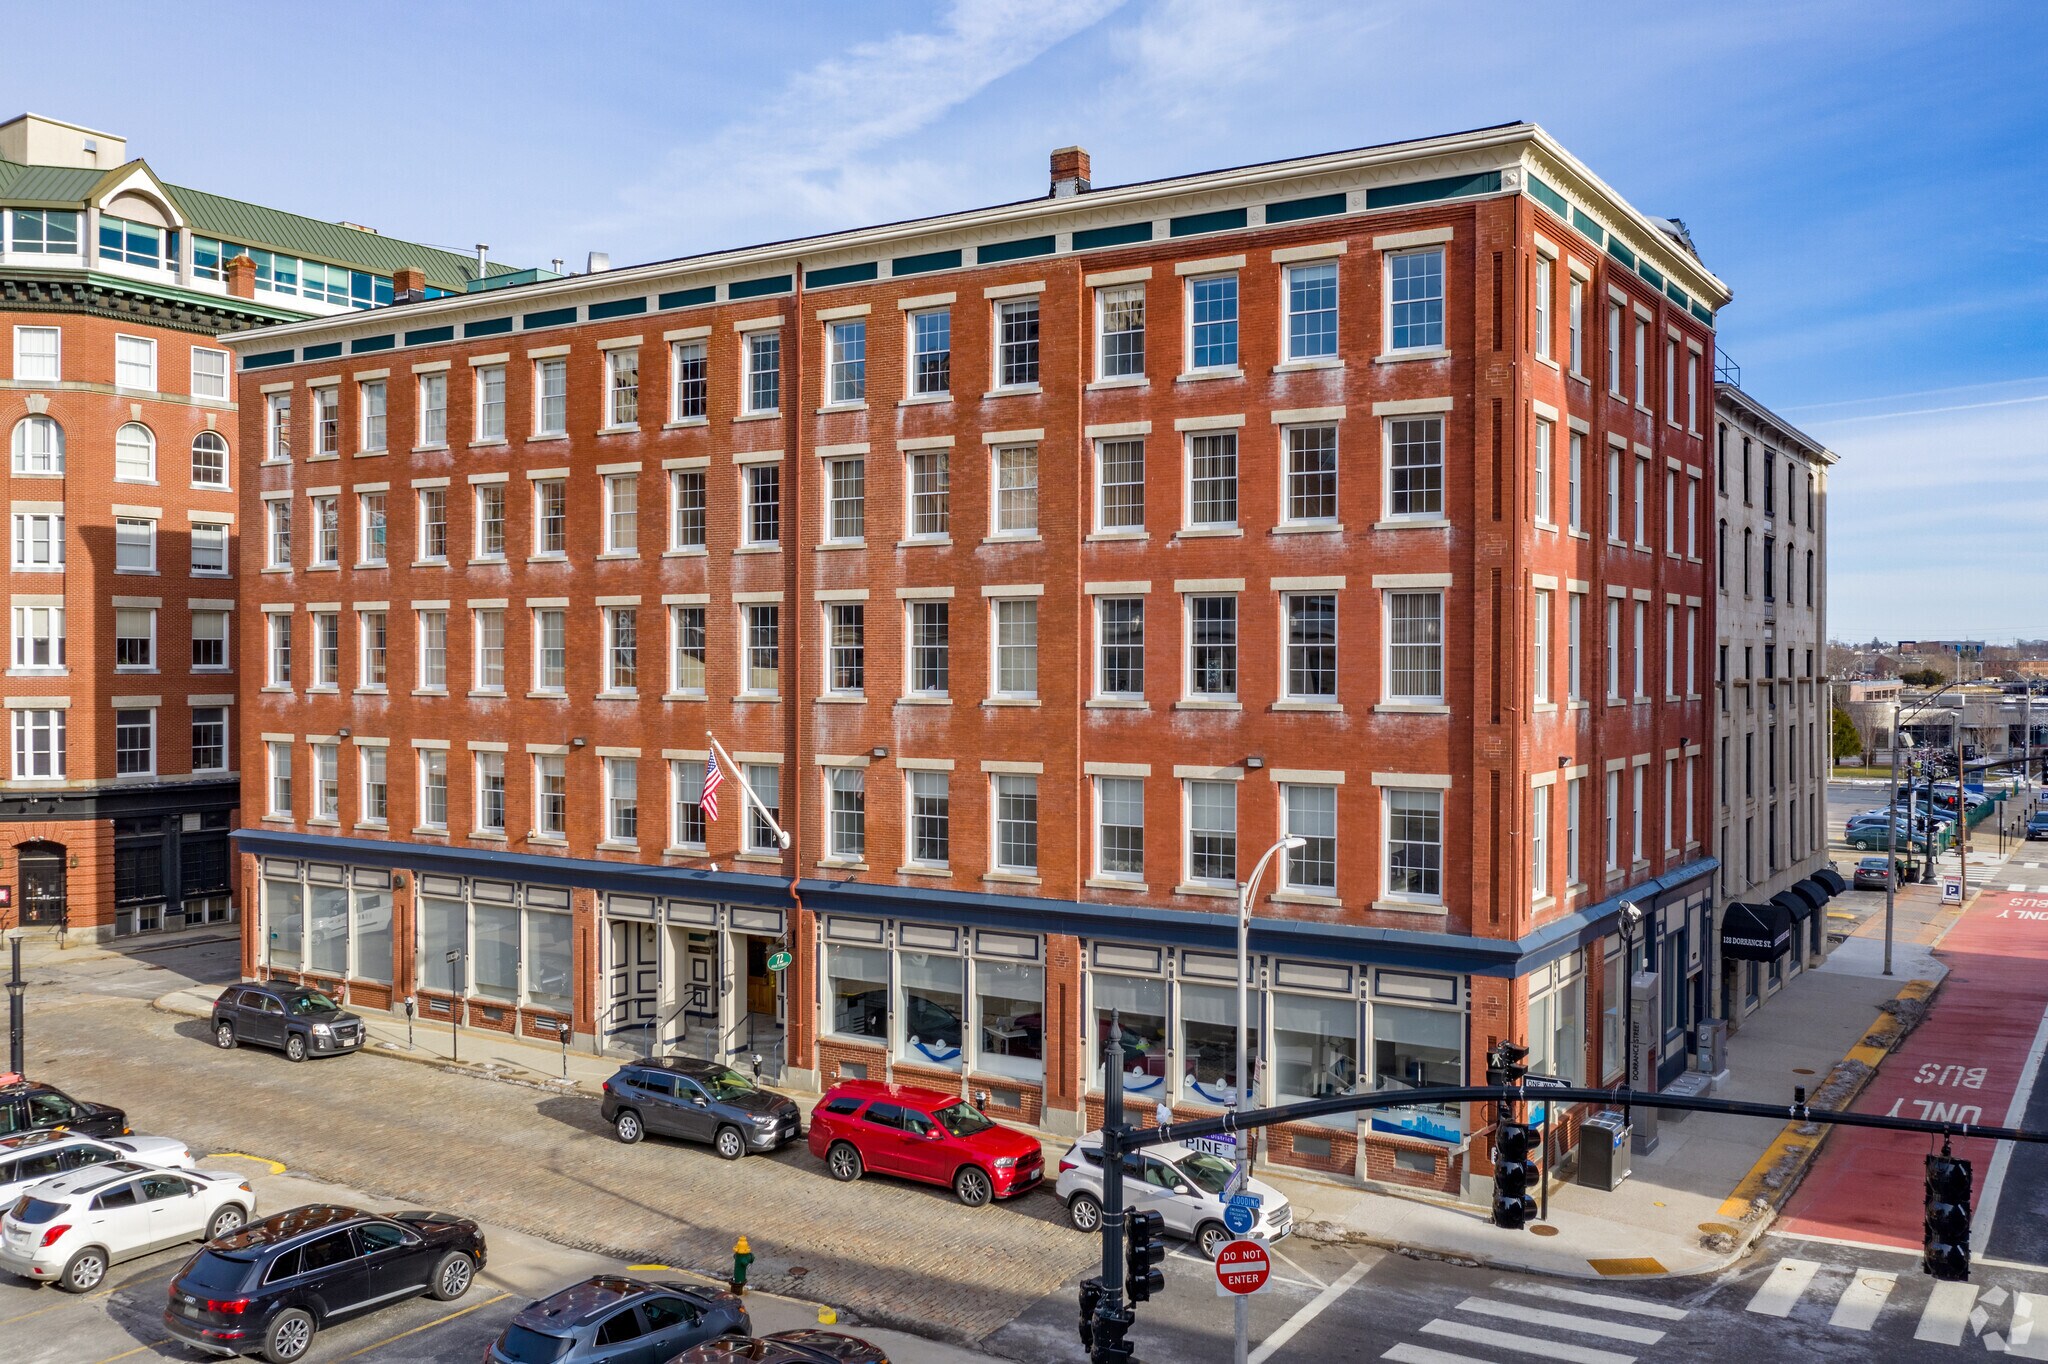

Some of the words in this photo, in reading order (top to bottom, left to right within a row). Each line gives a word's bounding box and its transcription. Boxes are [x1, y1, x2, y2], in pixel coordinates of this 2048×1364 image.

[1949, 886, 1956, 894] P
[2009, 897, 2048, 908] BUS
[1996, 909, 2048, 920] ONLY
[1732, 937, 1763, 947] DORRANCE
[776, 953, 784, 965] 72
[1632, 1021, 1640, 1044] STREET
[1632, 1044, 1640, 1081] DORRANCE
[1913, 1063, 1987, 1089] BUS
[1527, 1080, 1541, 1088] ONE
[1185, 1138, 1223, 1156] PINE
[1230, 1195, 1259, 1208] LOODING
[1223, 1251, 1236, 1261] DO
[1242, 1250, 1261, 1260] NOT
[1228, 1273, 1259, 1285] ENTER
